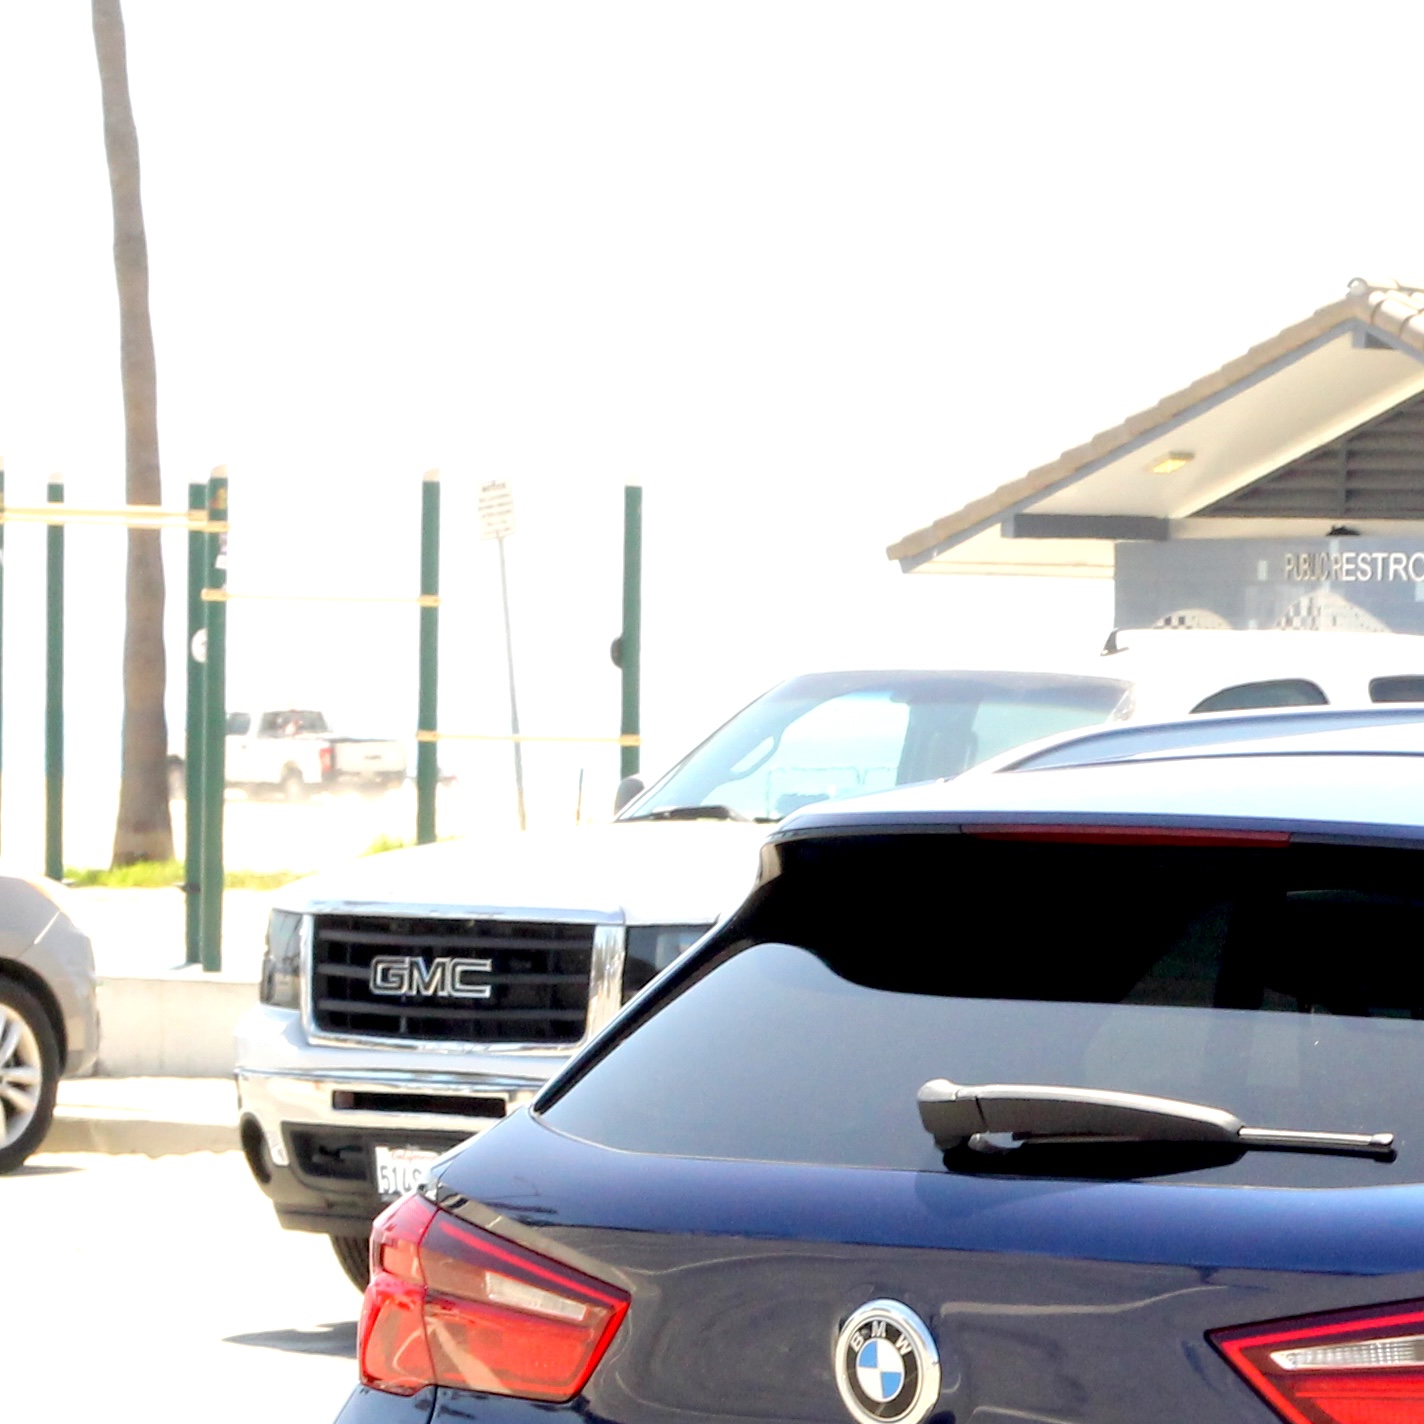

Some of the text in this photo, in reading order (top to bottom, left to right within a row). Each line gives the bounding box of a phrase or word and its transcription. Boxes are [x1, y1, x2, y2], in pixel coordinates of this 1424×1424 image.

[1284, 553, 1329, 581] PUBLIC
[370, 955, 493, 999] GMC
[850, 1321, 913, 1355] BMW
